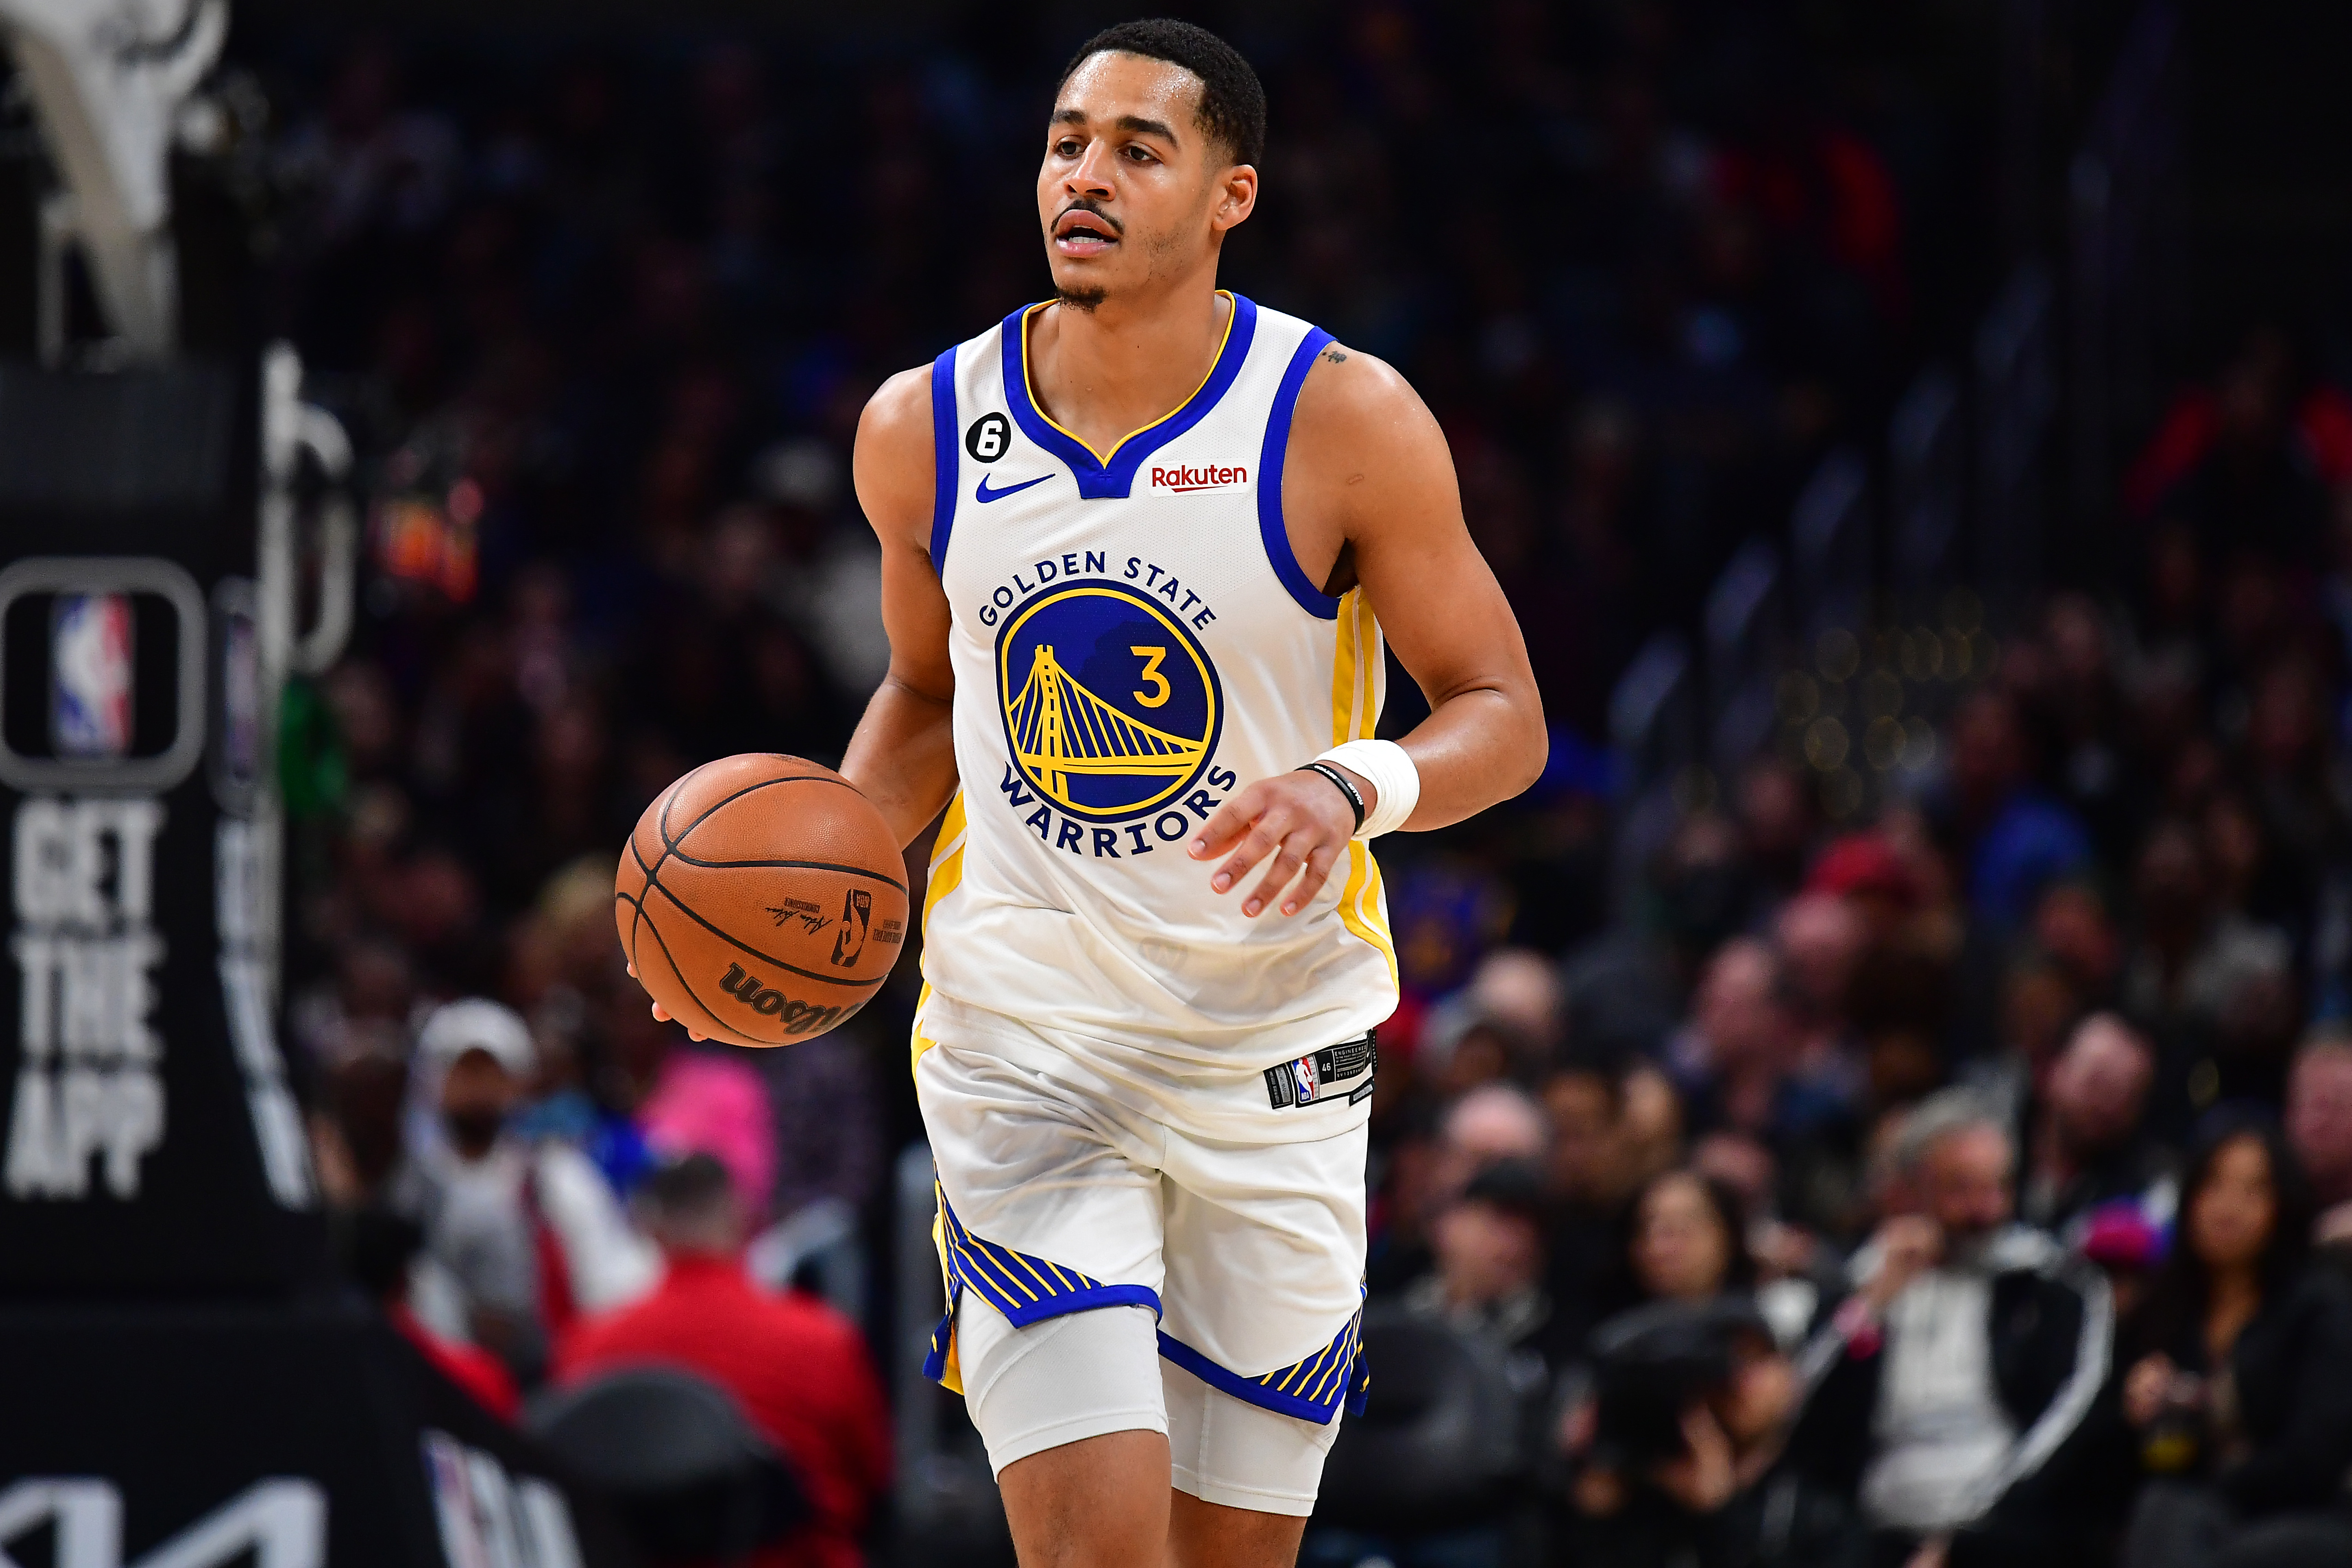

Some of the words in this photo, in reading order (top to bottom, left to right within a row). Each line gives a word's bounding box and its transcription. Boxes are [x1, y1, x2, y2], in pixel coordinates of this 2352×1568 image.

[976, 420, 1003, 457] 6
[1152, 464, 1248, 487] Rakuten
[979, 550, 1106, 627] GOLDEN
[1123, 556, 1217, 631] STATE
[1130, 646, 1171, 708] 3
[999, 760, 1237, 859] WARRIORS
[784, 897, 821, 914] COMMISSIONER
[1322, 1062, 1331, 1072] 46
